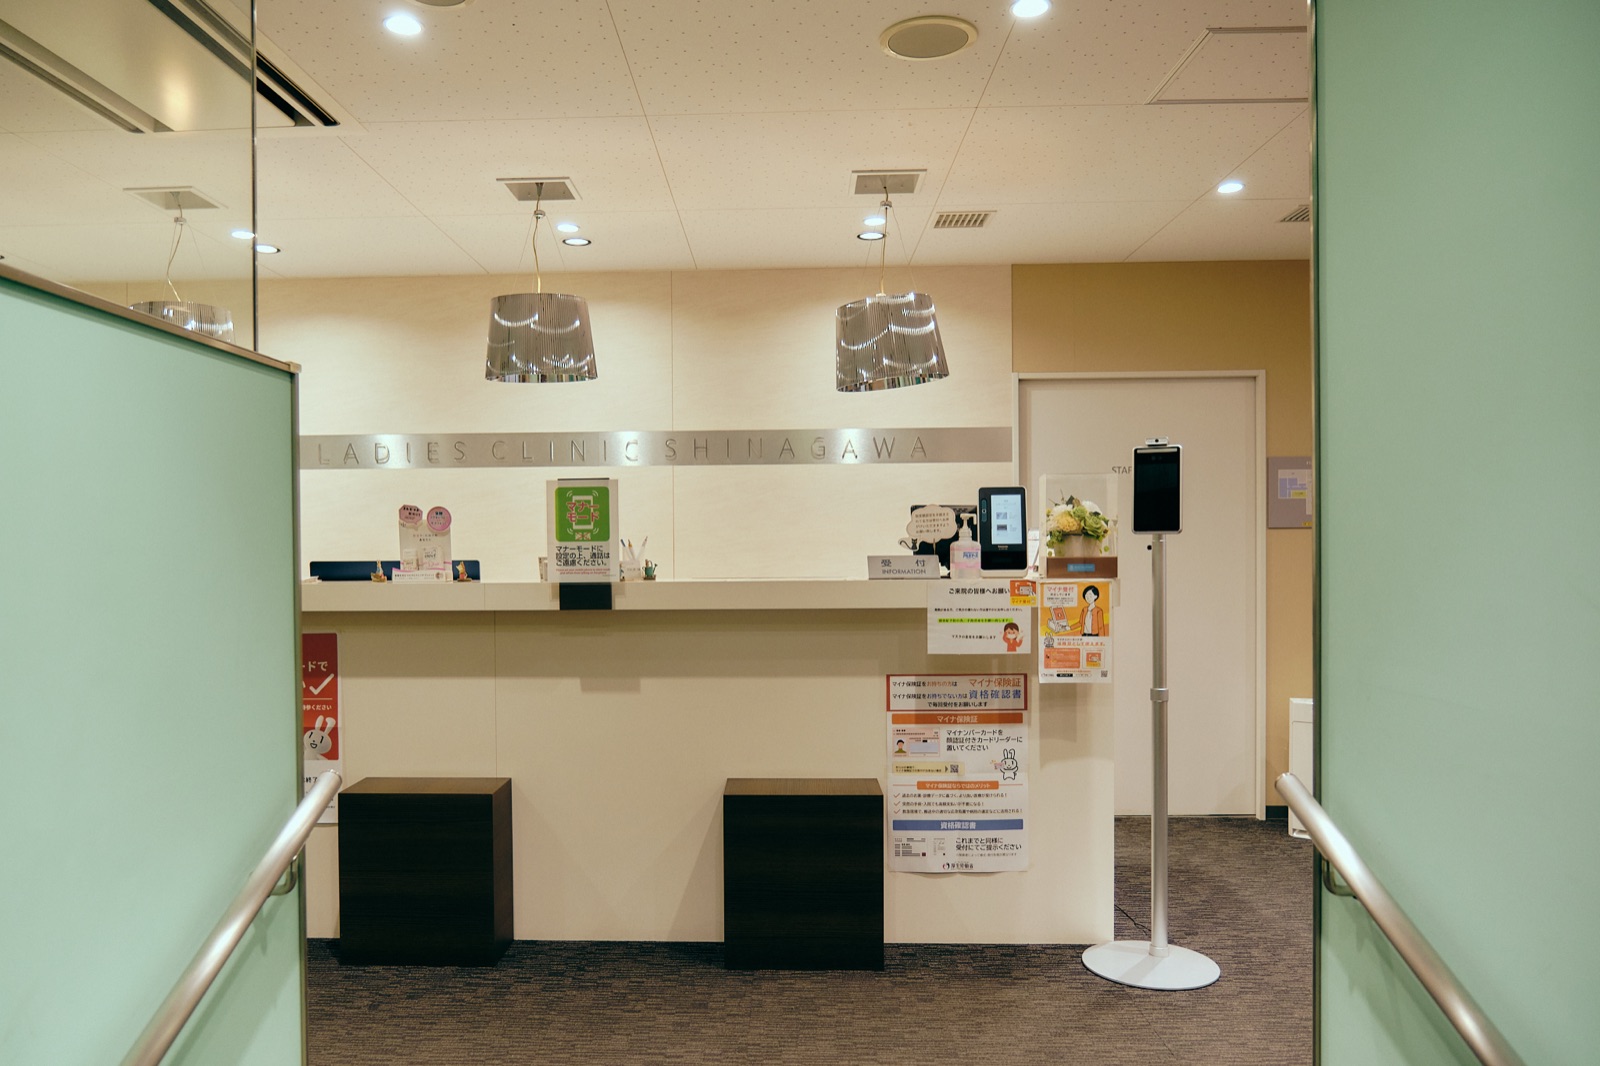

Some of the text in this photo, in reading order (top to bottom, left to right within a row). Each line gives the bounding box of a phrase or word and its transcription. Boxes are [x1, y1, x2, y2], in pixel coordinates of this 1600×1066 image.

[318, 436, 928, 465] LADIES CLINIC SHINAGAWA
[566, 501, 599, 512] マナー
[567, 512, 599, 522] モード
[555, 552, 610, 560] 設定の上、通話は
[881, 559, 925, 567] 受 付
[969, 678, 1021, 687] マイナ保険証
[969, 689, 1021, 699] 資格確認書
[936, 715, 978, 723] マイナ保険証
[946, 736, 1023, 744] 顔認証付きカードリーダーに
[940, 821, 977, 829] 資格確認書
[955, 843, 1022, 851] 受付にてご提示ください
